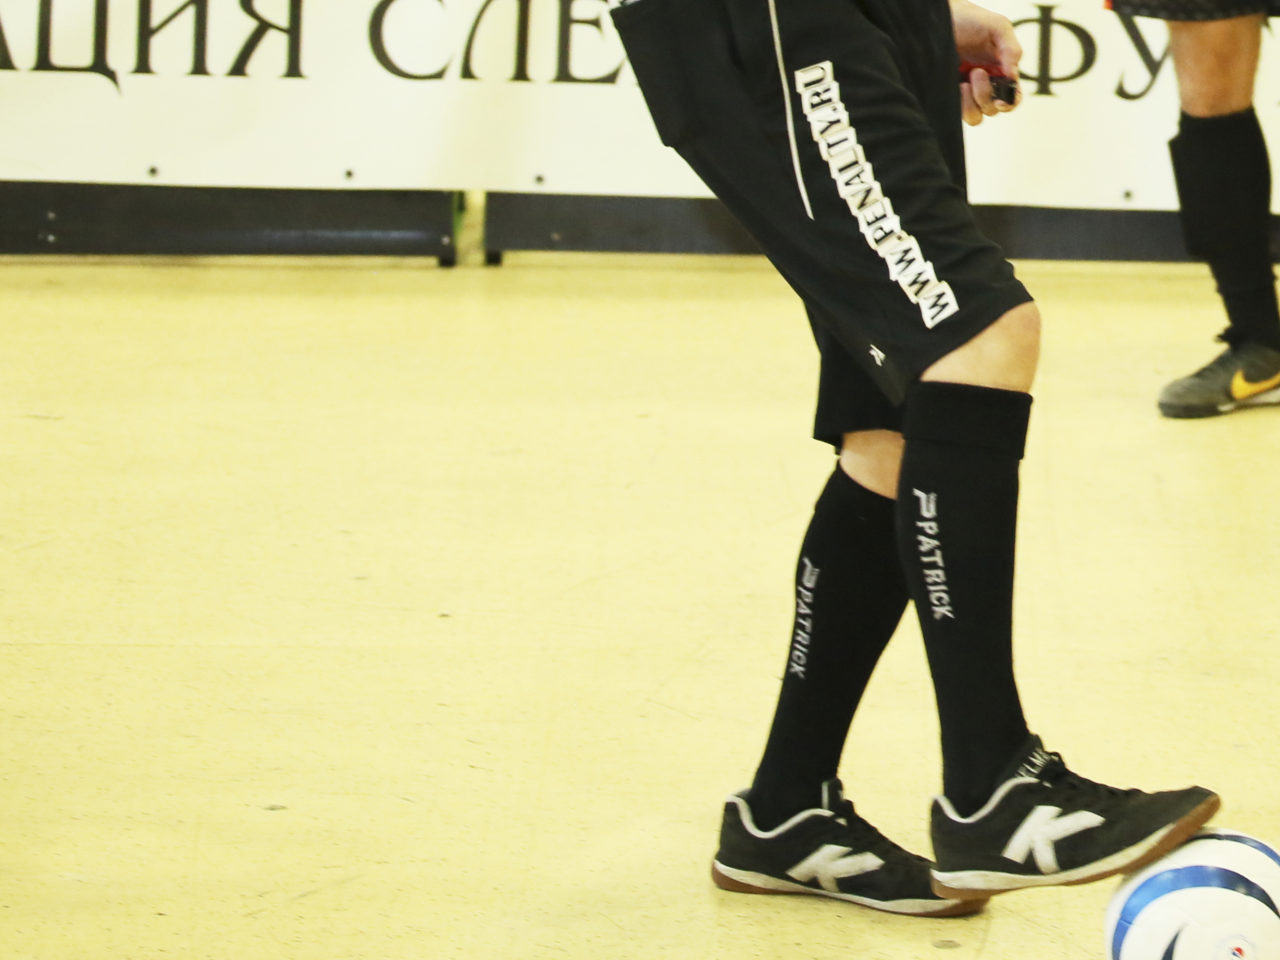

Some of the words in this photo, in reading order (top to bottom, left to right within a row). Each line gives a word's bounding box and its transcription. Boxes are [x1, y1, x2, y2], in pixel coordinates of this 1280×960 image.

[798, 62, 954, 325] WWW.PENALTY.RU
[916, 521, 955, 620] PATRICK
[789, 586, 813, 678] PATRICK
